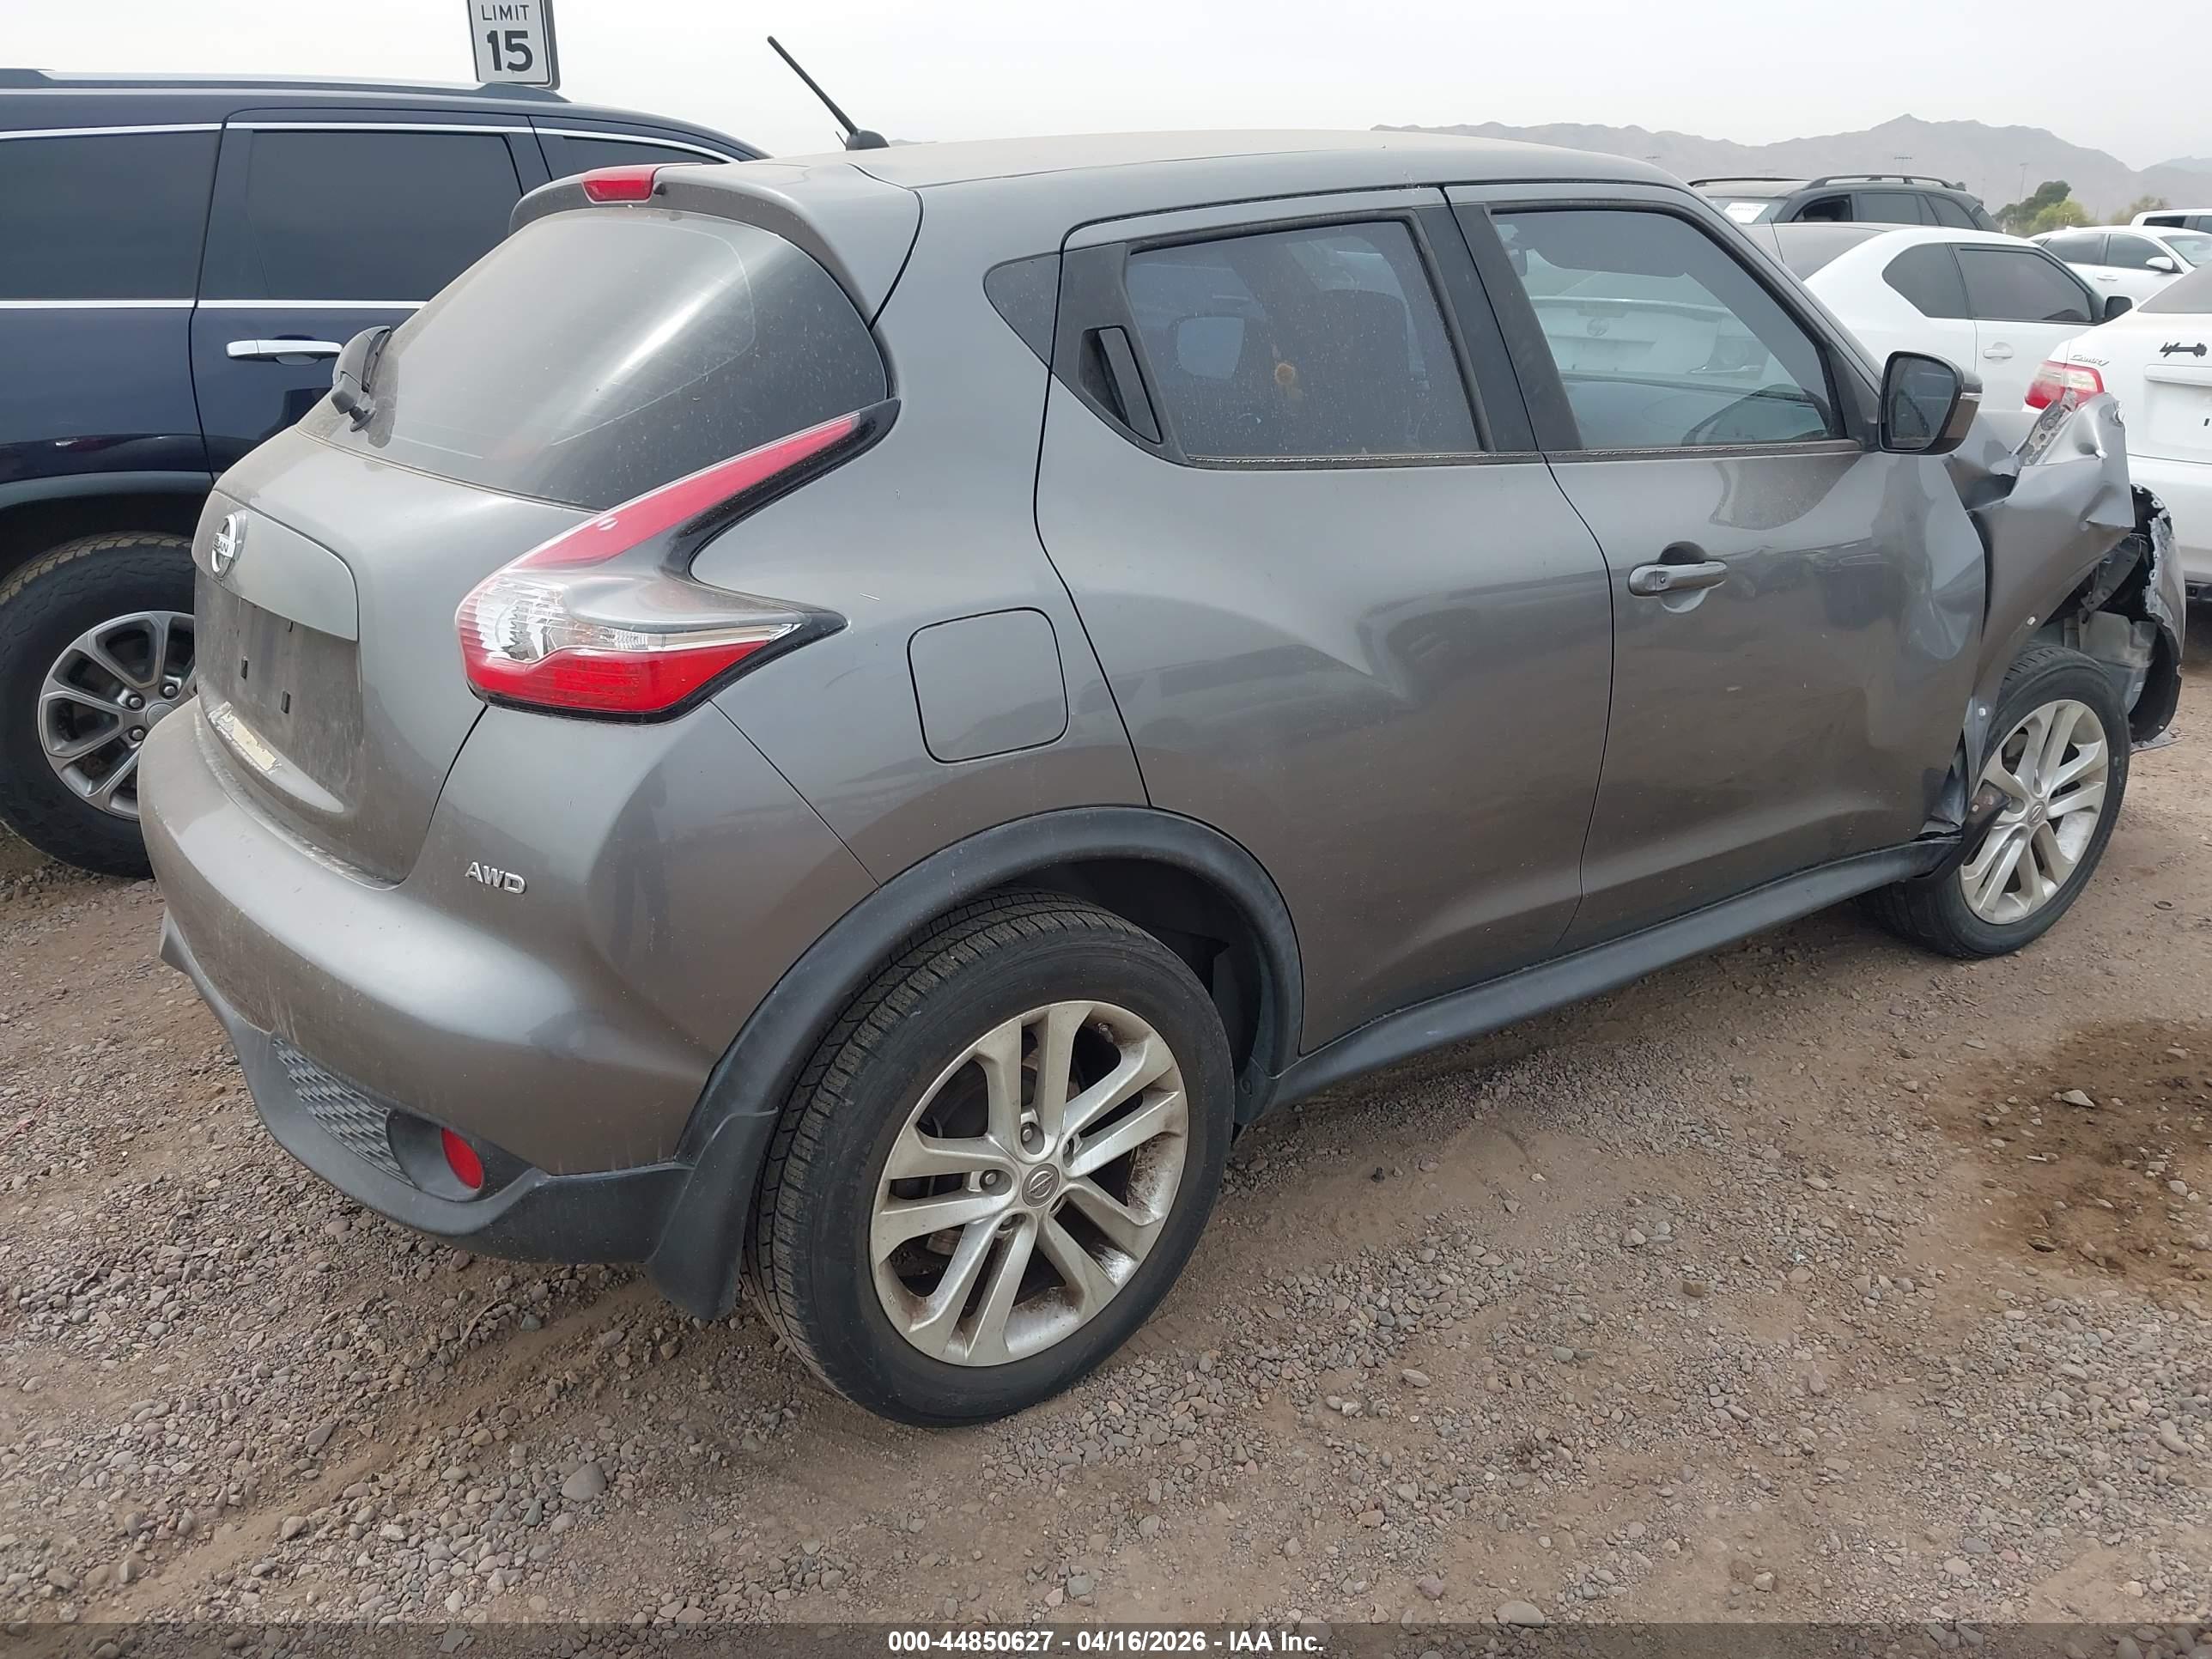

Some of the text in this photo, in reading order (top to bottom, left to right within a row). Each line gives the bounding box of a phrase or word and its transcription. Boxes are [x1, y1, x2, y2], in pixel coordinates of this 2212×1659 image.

[481, 4, 529, 21] LIMIT
[486, 30, 533, 72] 15
[465, 861, 526, 894] AWD
